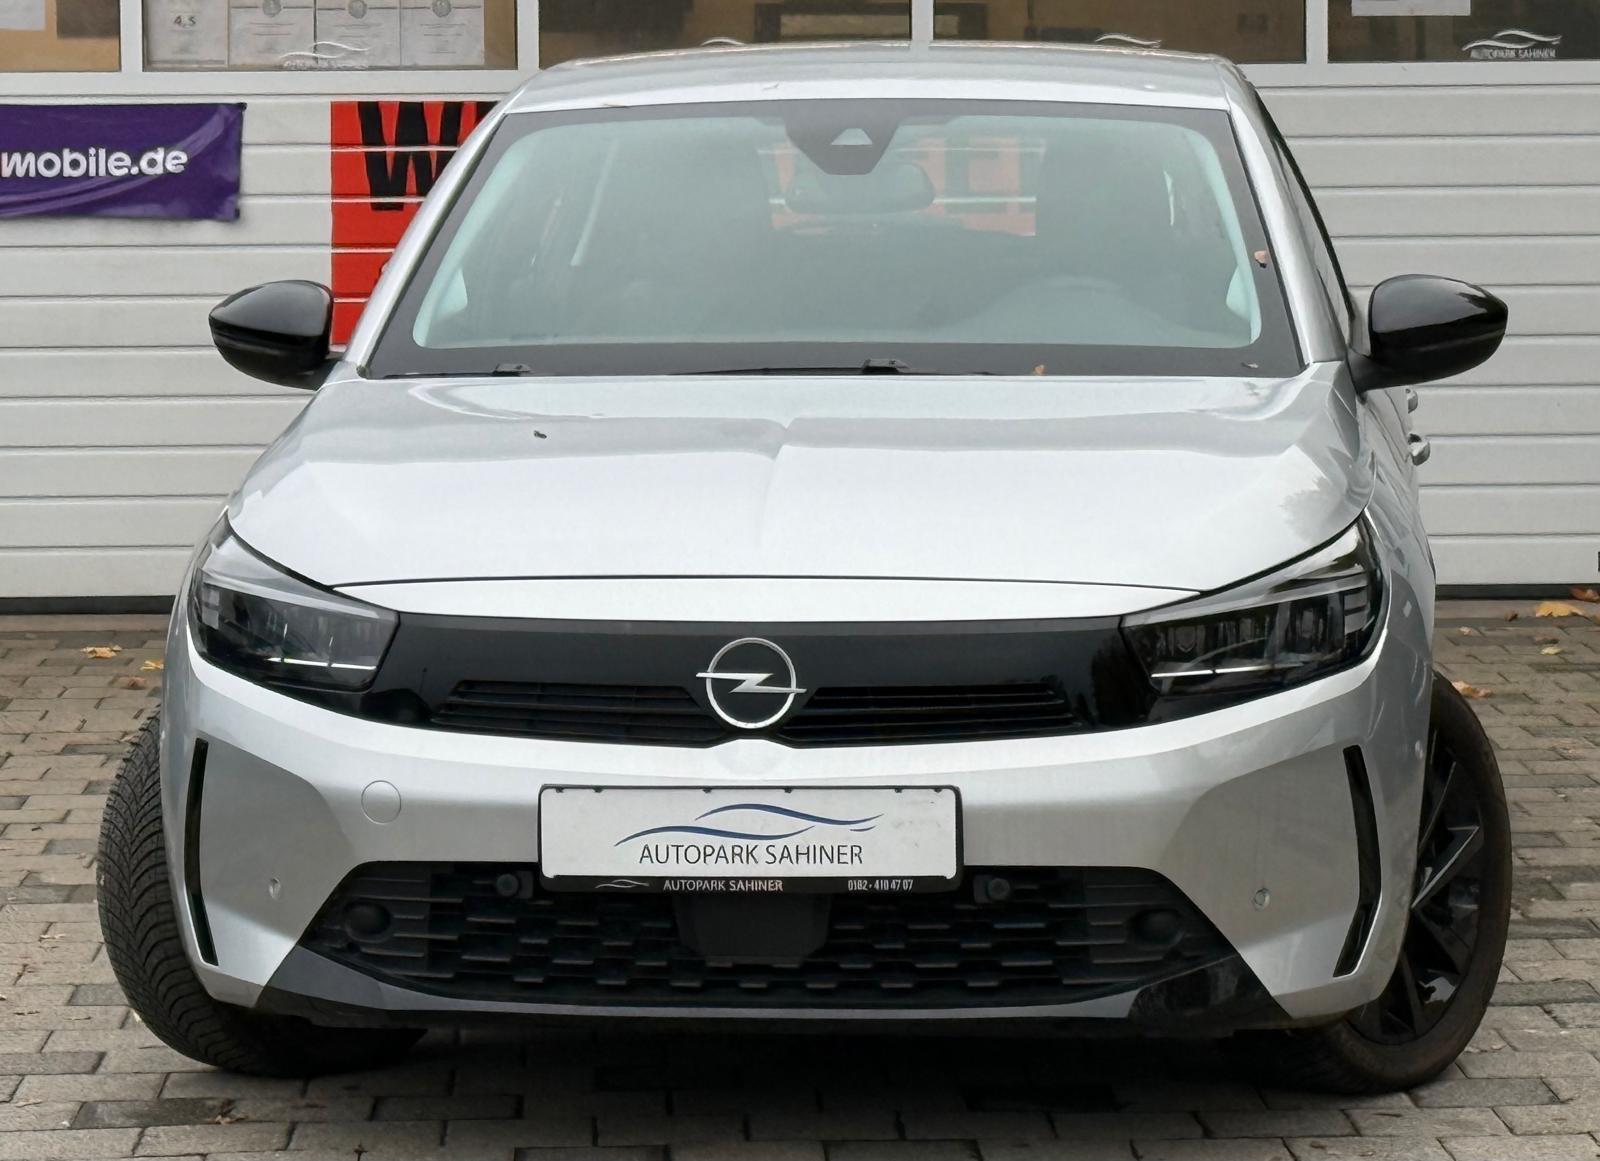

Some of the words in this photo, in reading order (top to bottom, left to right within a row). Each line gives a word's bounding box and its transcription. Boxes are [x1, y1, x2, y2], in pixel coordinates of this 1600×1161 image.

[1, 147, 188, 178] mobile.de
[639, 844, 759, 865] AUTOPARK
[765, 844, 863, 865] SAHINER
[663, 880, 726, 891] AUTOPARK
[729, 880, 783, 892] SAHINER
